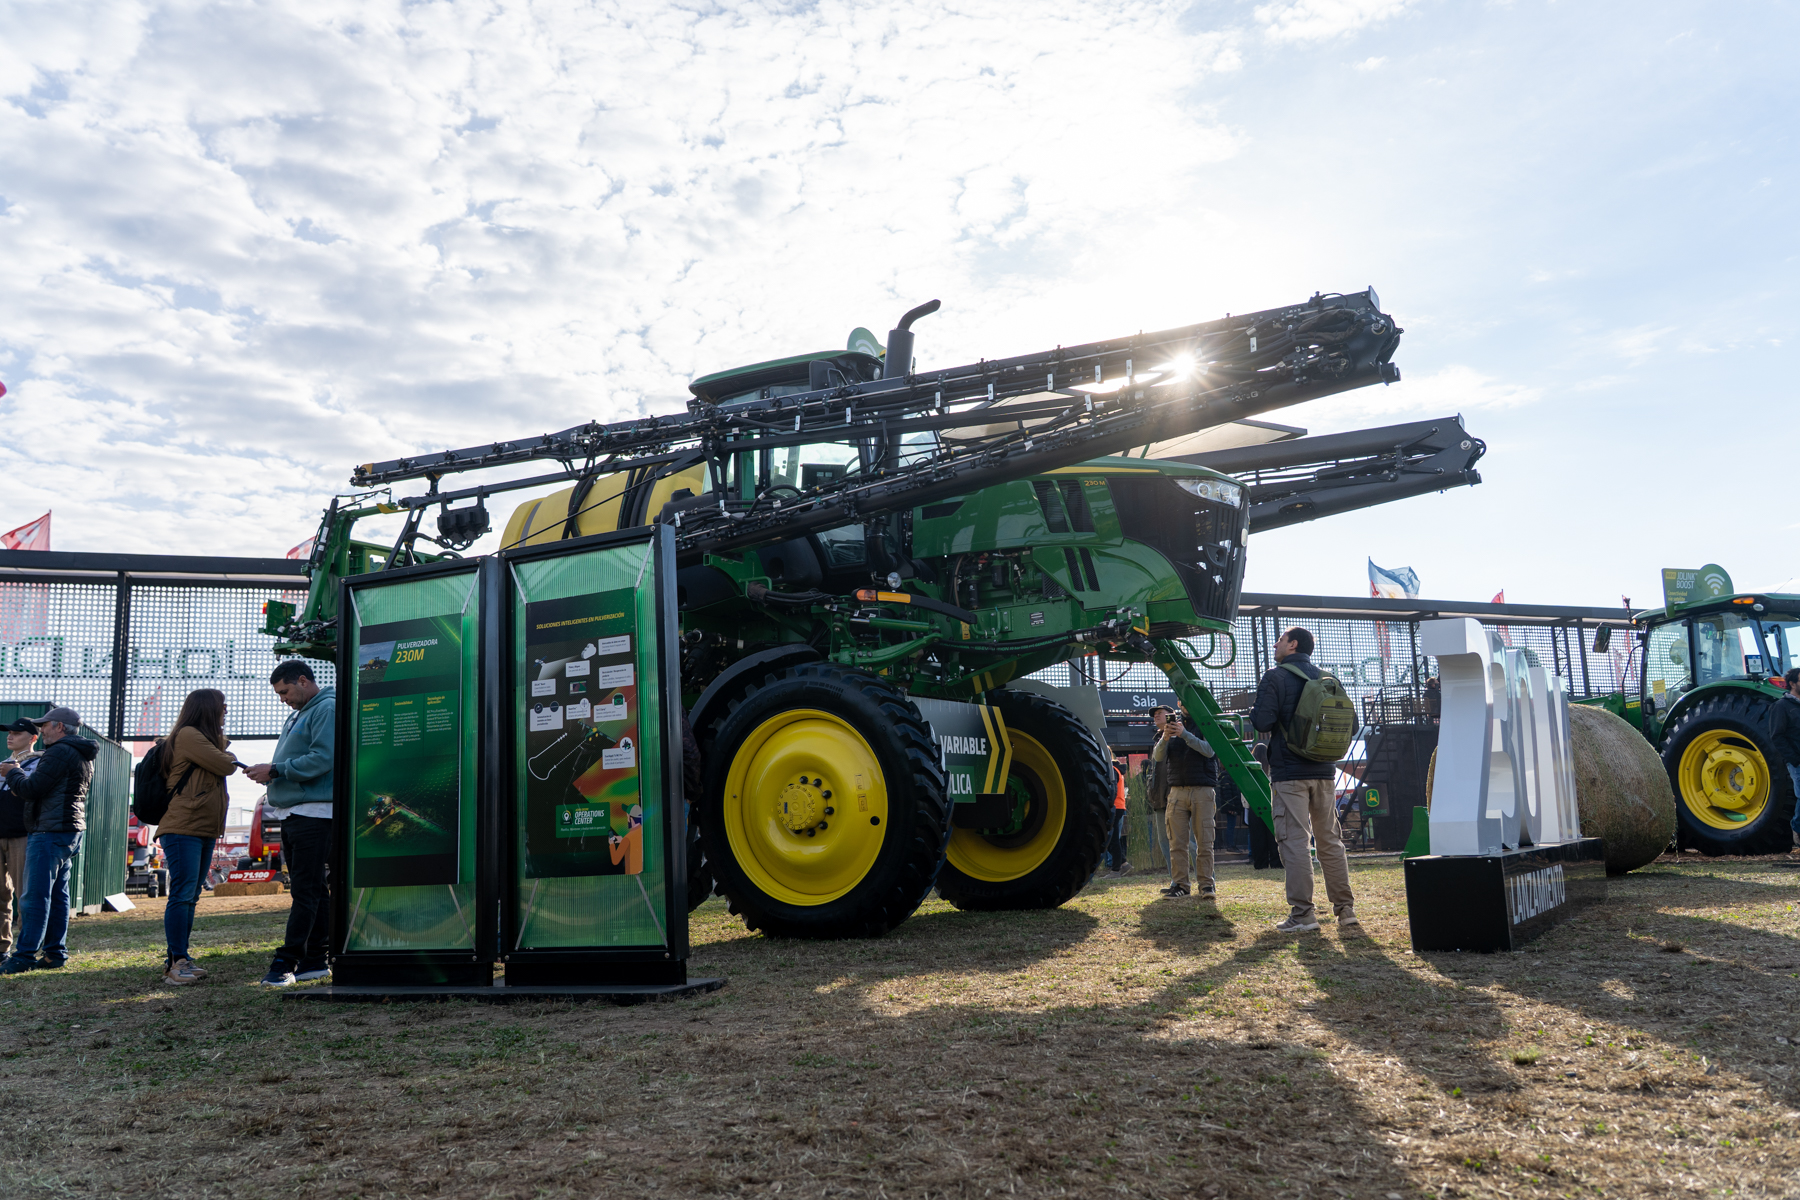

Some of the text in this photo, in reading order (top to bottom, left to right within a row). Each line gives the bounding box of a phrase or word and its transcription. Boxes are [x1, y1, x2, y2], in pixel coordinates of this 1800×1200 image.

[1676, 580, 1695, 589] BOOST
[536, 621, 561, 630] SOLUCIONES
[561, 617, 588, 626] INTELIGENTES
[594, 611, 625, 622] PULVERIZACIÓN
[397, 638, 438, 650] PULVERIZADORA
[395, 648, 425, 664] 230M
[1132, 694, 1157, 707] Sala
[939, 735, 987, 755] VARIABLE
[950, 773, 973, 795] LICA
[574, 809, 605, 819] OPERATIONS
[574, 817, 593, 825] CENTER
[243, 871, 270, 879] 71.100
[1510, 863, 1566, 925] LANZAMIENTO
